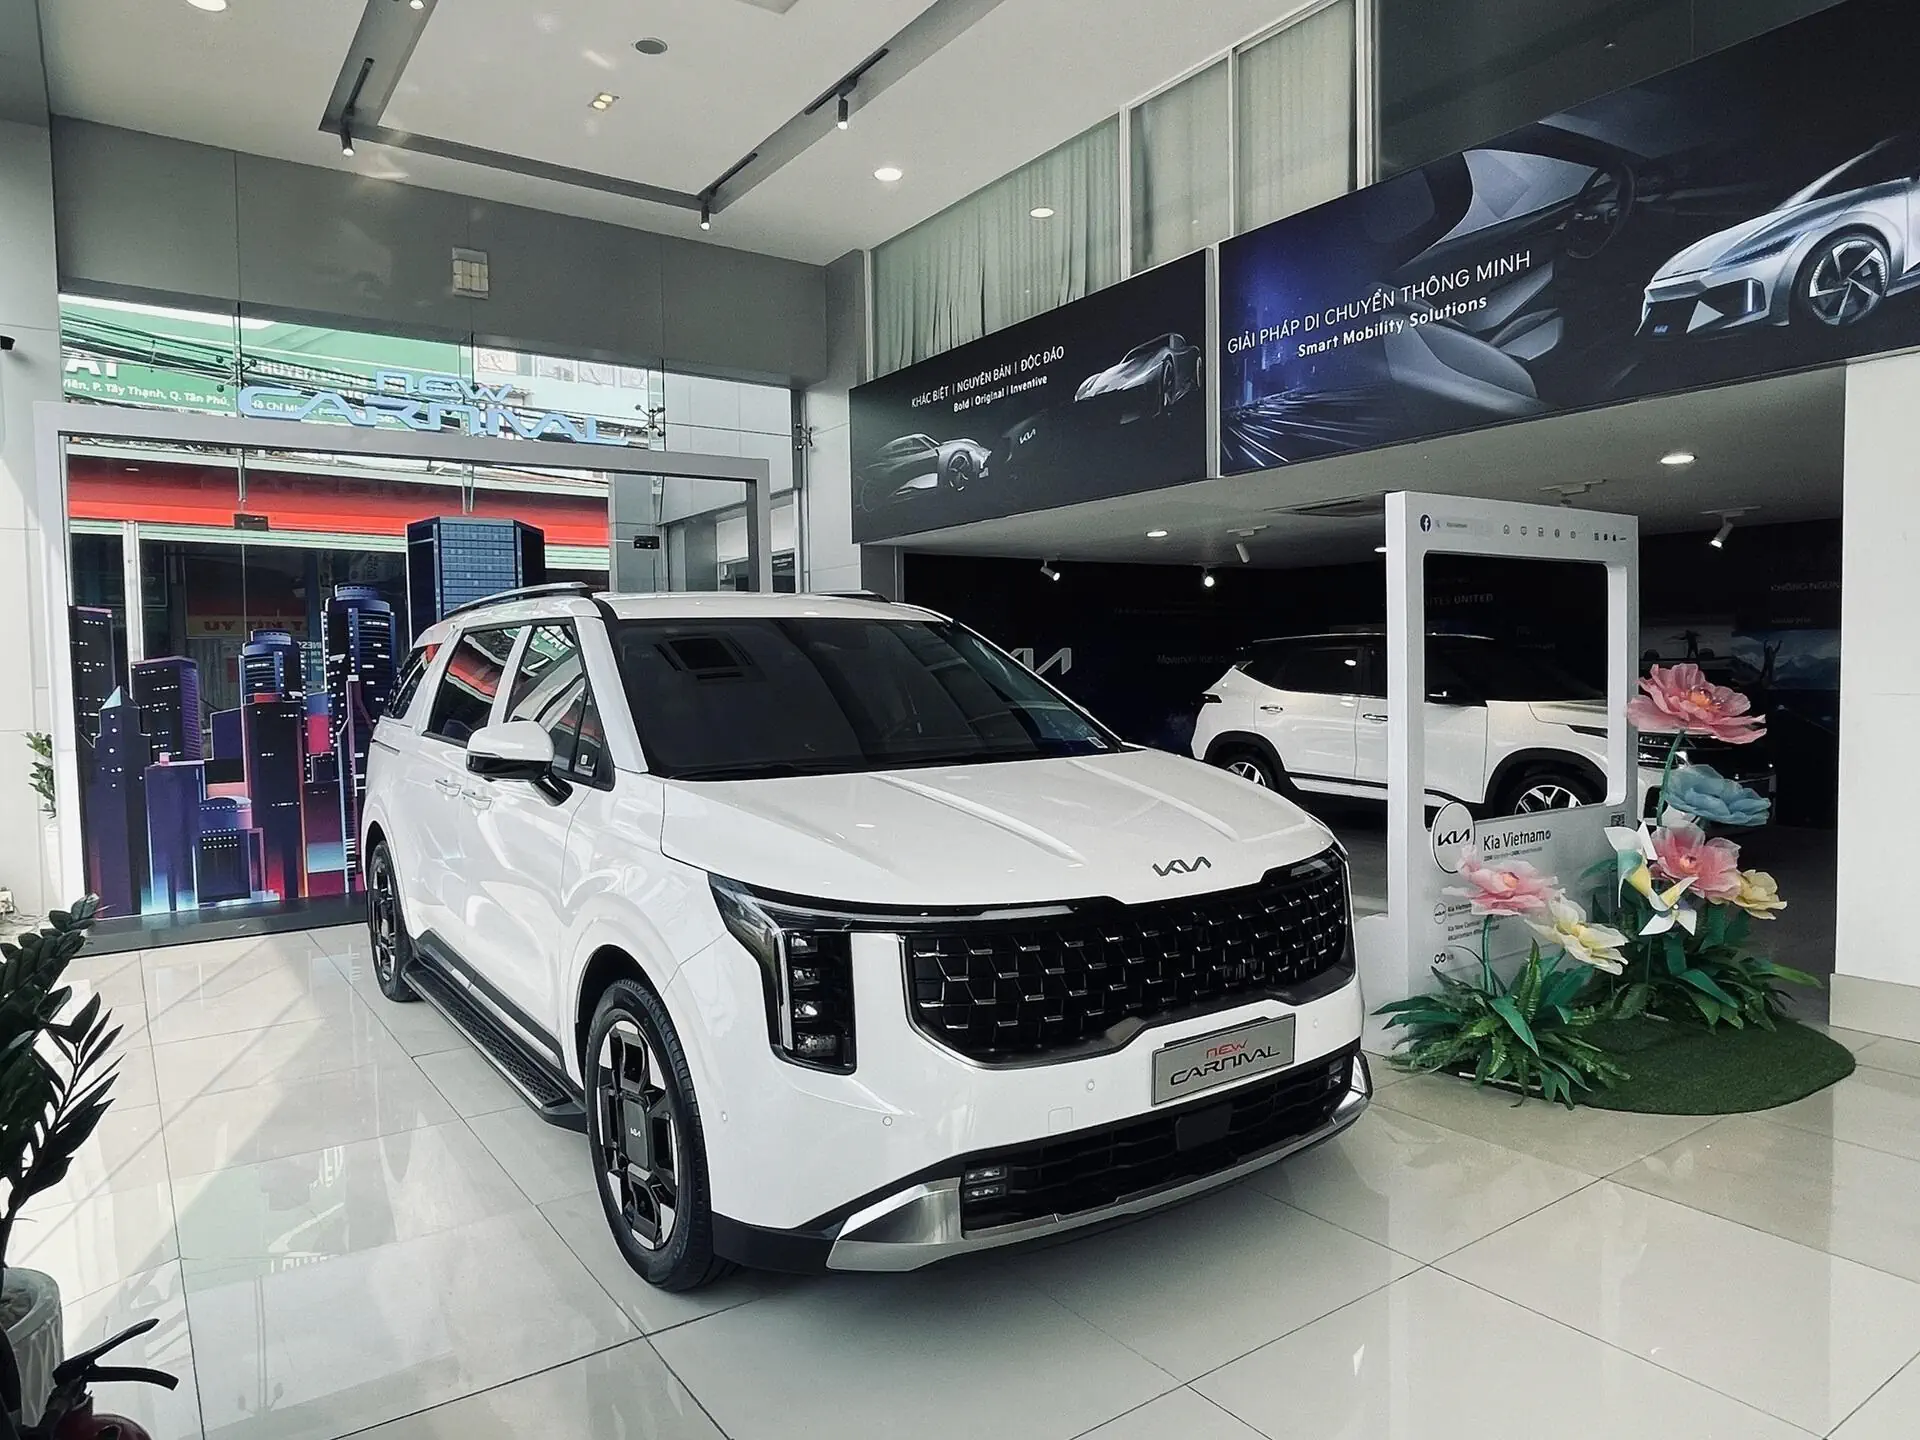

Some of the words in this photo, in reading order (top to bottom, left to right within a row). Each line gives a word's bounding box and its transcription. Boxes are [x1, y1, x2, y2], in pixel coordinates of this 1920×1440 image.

[1227, 330, 1256, 354] GIẢI
[1260, 318, 1300, 345] PHÁP
[1304, 312, 1320, 332] DI
[1324, 288, 1395, 326] CHUYỂN
[1400, 269, 1470, 303] THÔNG
[1476, 250, 1531, 282] MINH
[1298, 335, 1339, 358] Smart
[1343, 319, 1404, 346] Mobility
[1410, 296, 1487, 328] Solutions
[106, 383, 125, 396] Tây
[911, 392, 931, 408] KHÁC
[933, 385, 949, 401] BIỆT
[1020, 353, 1041, 373] ĐỘC
[1043, 345, 1065, 364] ĐÁO
[953, 400, 970, 413] Bold
[975, 387, 1005, 407] Original
[1010, 374, 1048, 395] Inventive
[238, 386, 629, 446] CARNIVAL
[1454, 591, 1494, 605] UNITED
[1437, 828, 1471, 847] KIA
[1483, 834, 1501, 851] Kia
[1503, 829, 1546, 848] Vietnam
[1152, 856, 1212, 876] KIA
[1170, 1045, 1281, 1086] CARNIVAL
